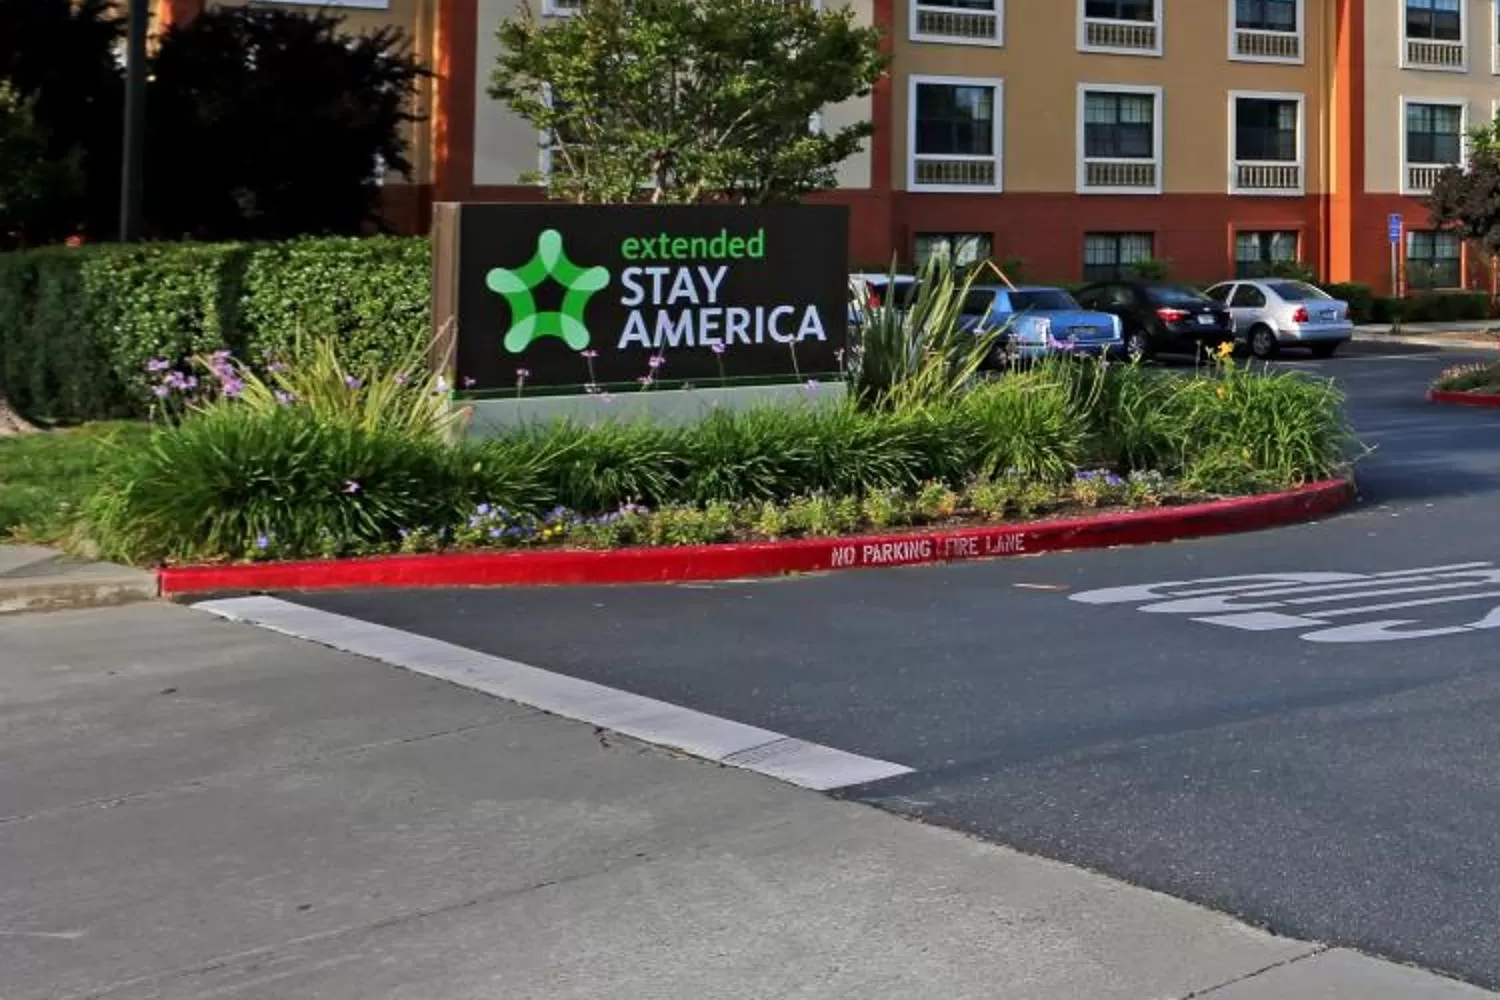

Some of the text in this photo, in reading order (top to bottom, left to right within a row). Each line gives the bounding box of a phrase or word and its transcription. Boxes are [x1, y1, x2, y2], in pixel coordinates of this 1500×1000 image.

[621, 228, 765, 260] extended
[620, 265, 730, 306] STAY
[617, 305, 827, 349] AMERICA
[831, 533, 1025, 567] NO PARKING FIRE LANE
